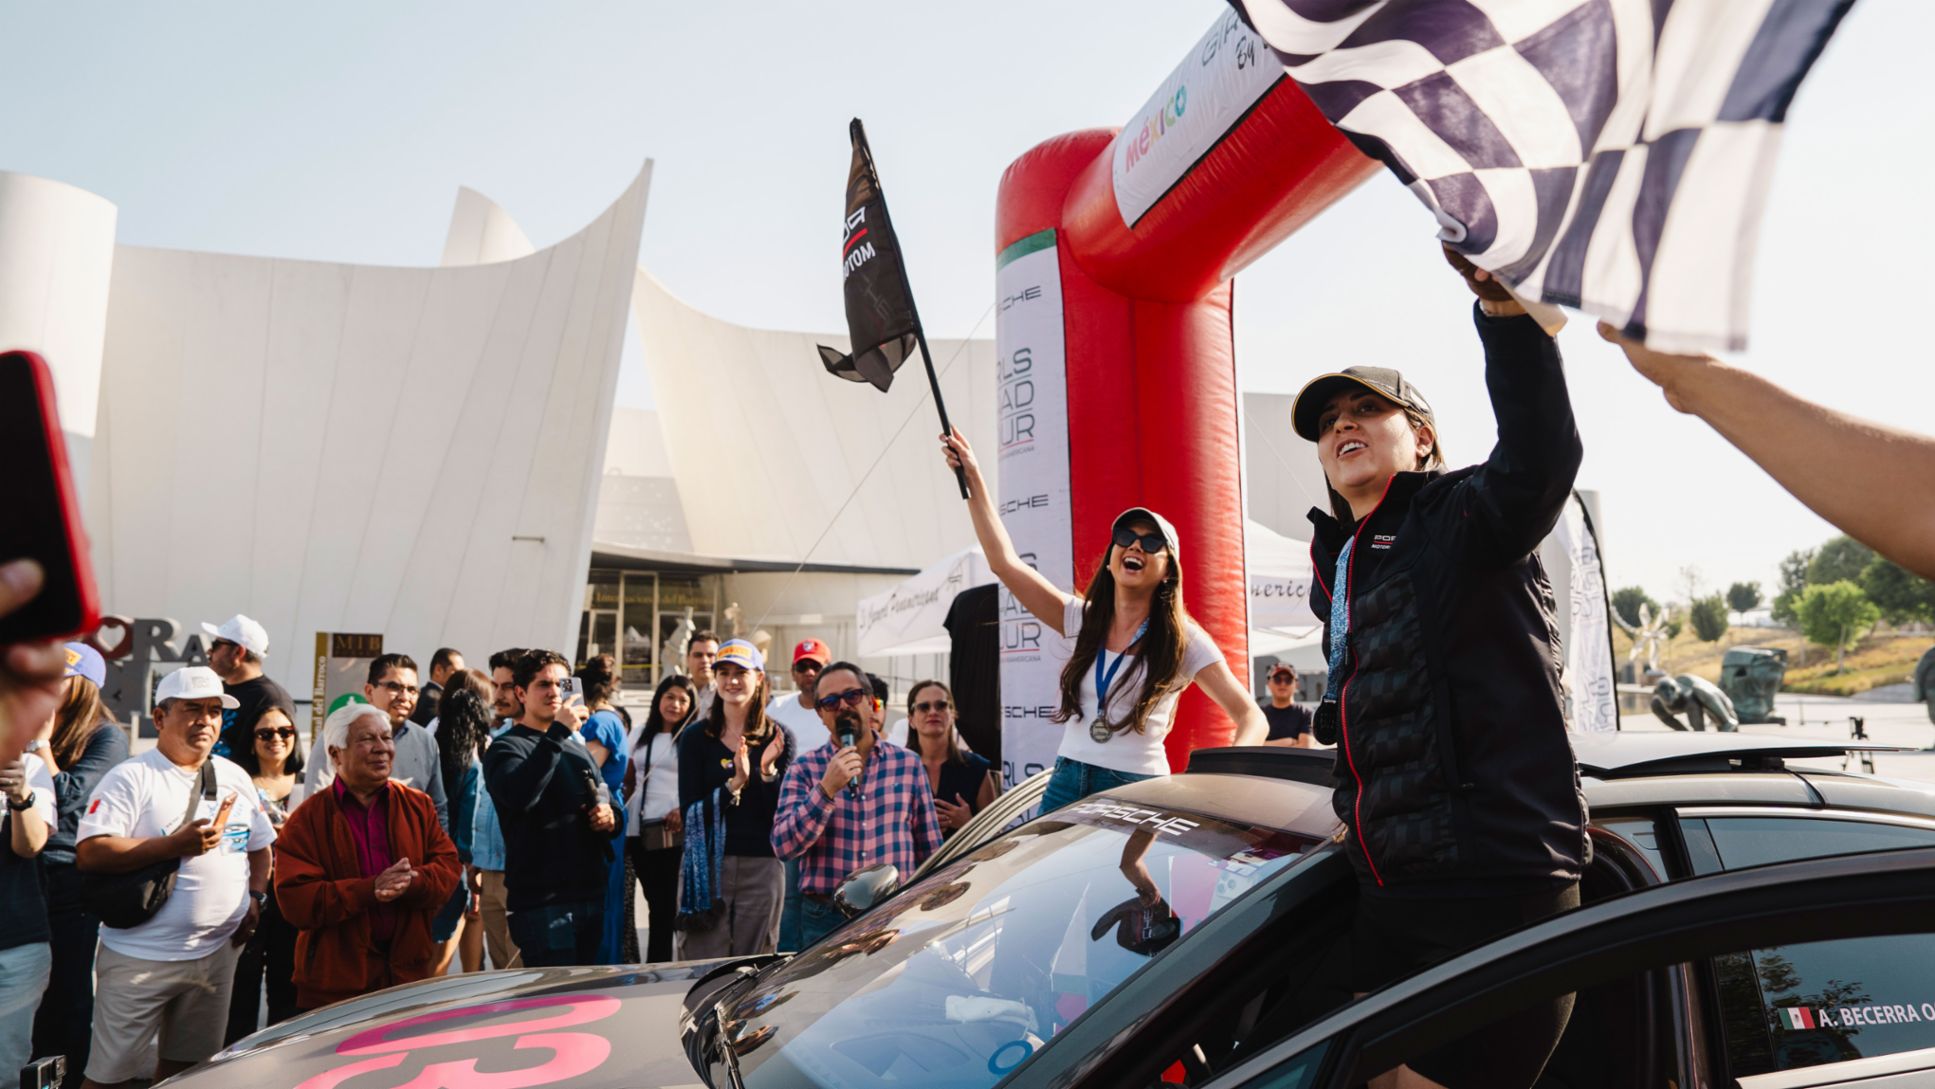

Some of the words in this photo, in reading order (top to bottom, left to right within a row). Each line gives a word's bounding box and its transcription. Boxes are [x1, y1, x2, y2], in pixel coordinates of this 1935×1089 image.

[1001, 285, 1041, 313] CHE
[1068, 803, 1200, 837] PORSCHE
[1818, 1008, 1839, 1028] A.
[1840, 1003, 1922, 1026] BECERRA
[1921, 1003, 1935, 1021] O
